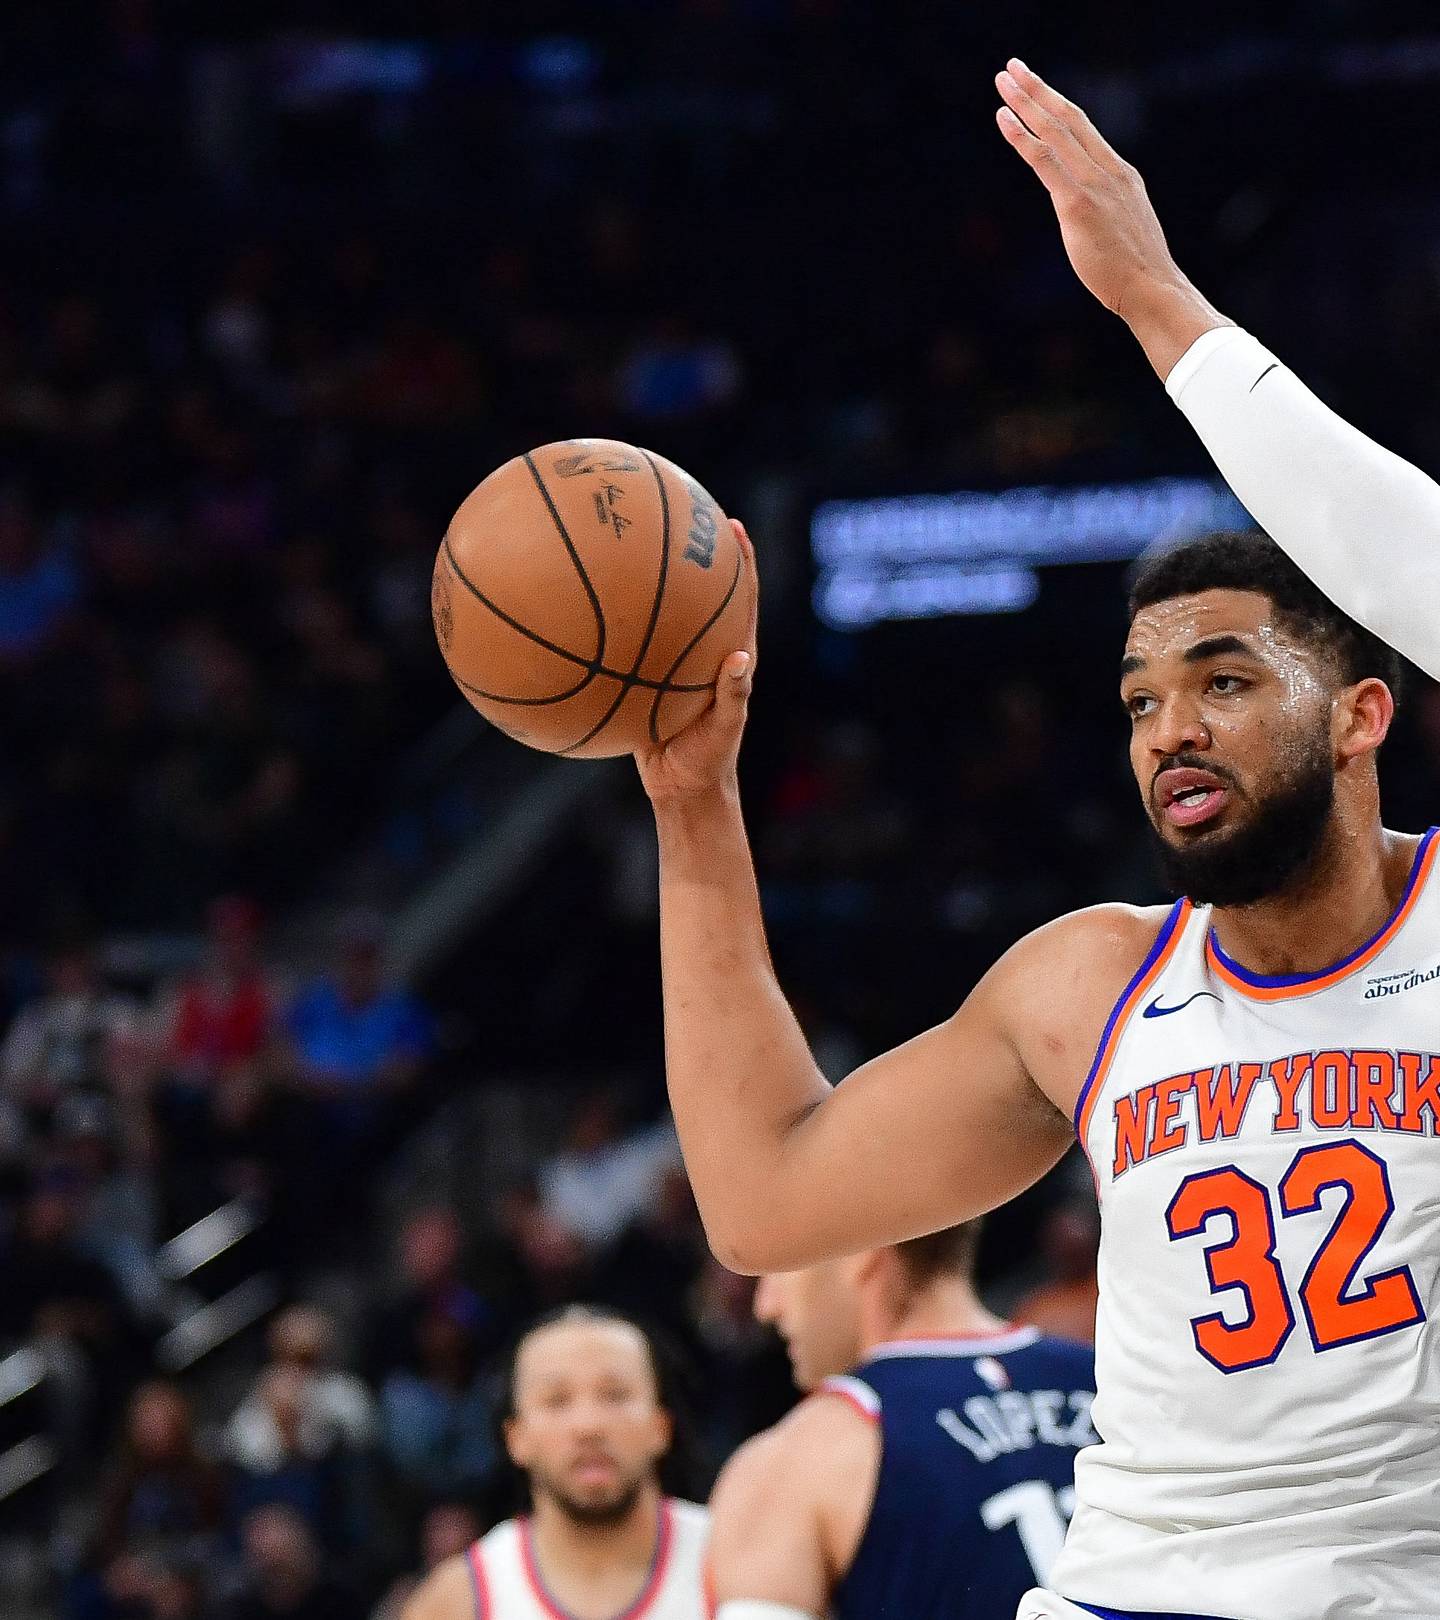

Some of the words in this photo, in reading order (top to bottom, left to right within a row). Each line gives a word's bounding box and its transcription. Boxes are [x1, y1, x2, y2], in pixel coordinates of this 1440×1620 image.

[1364, 984, 1400, 999] abu
[1112, 1060, 1263, 1182] NEW
[1165, 1137, 1427, 1375] 32
[979, 1478, 1076, 1590] 1
